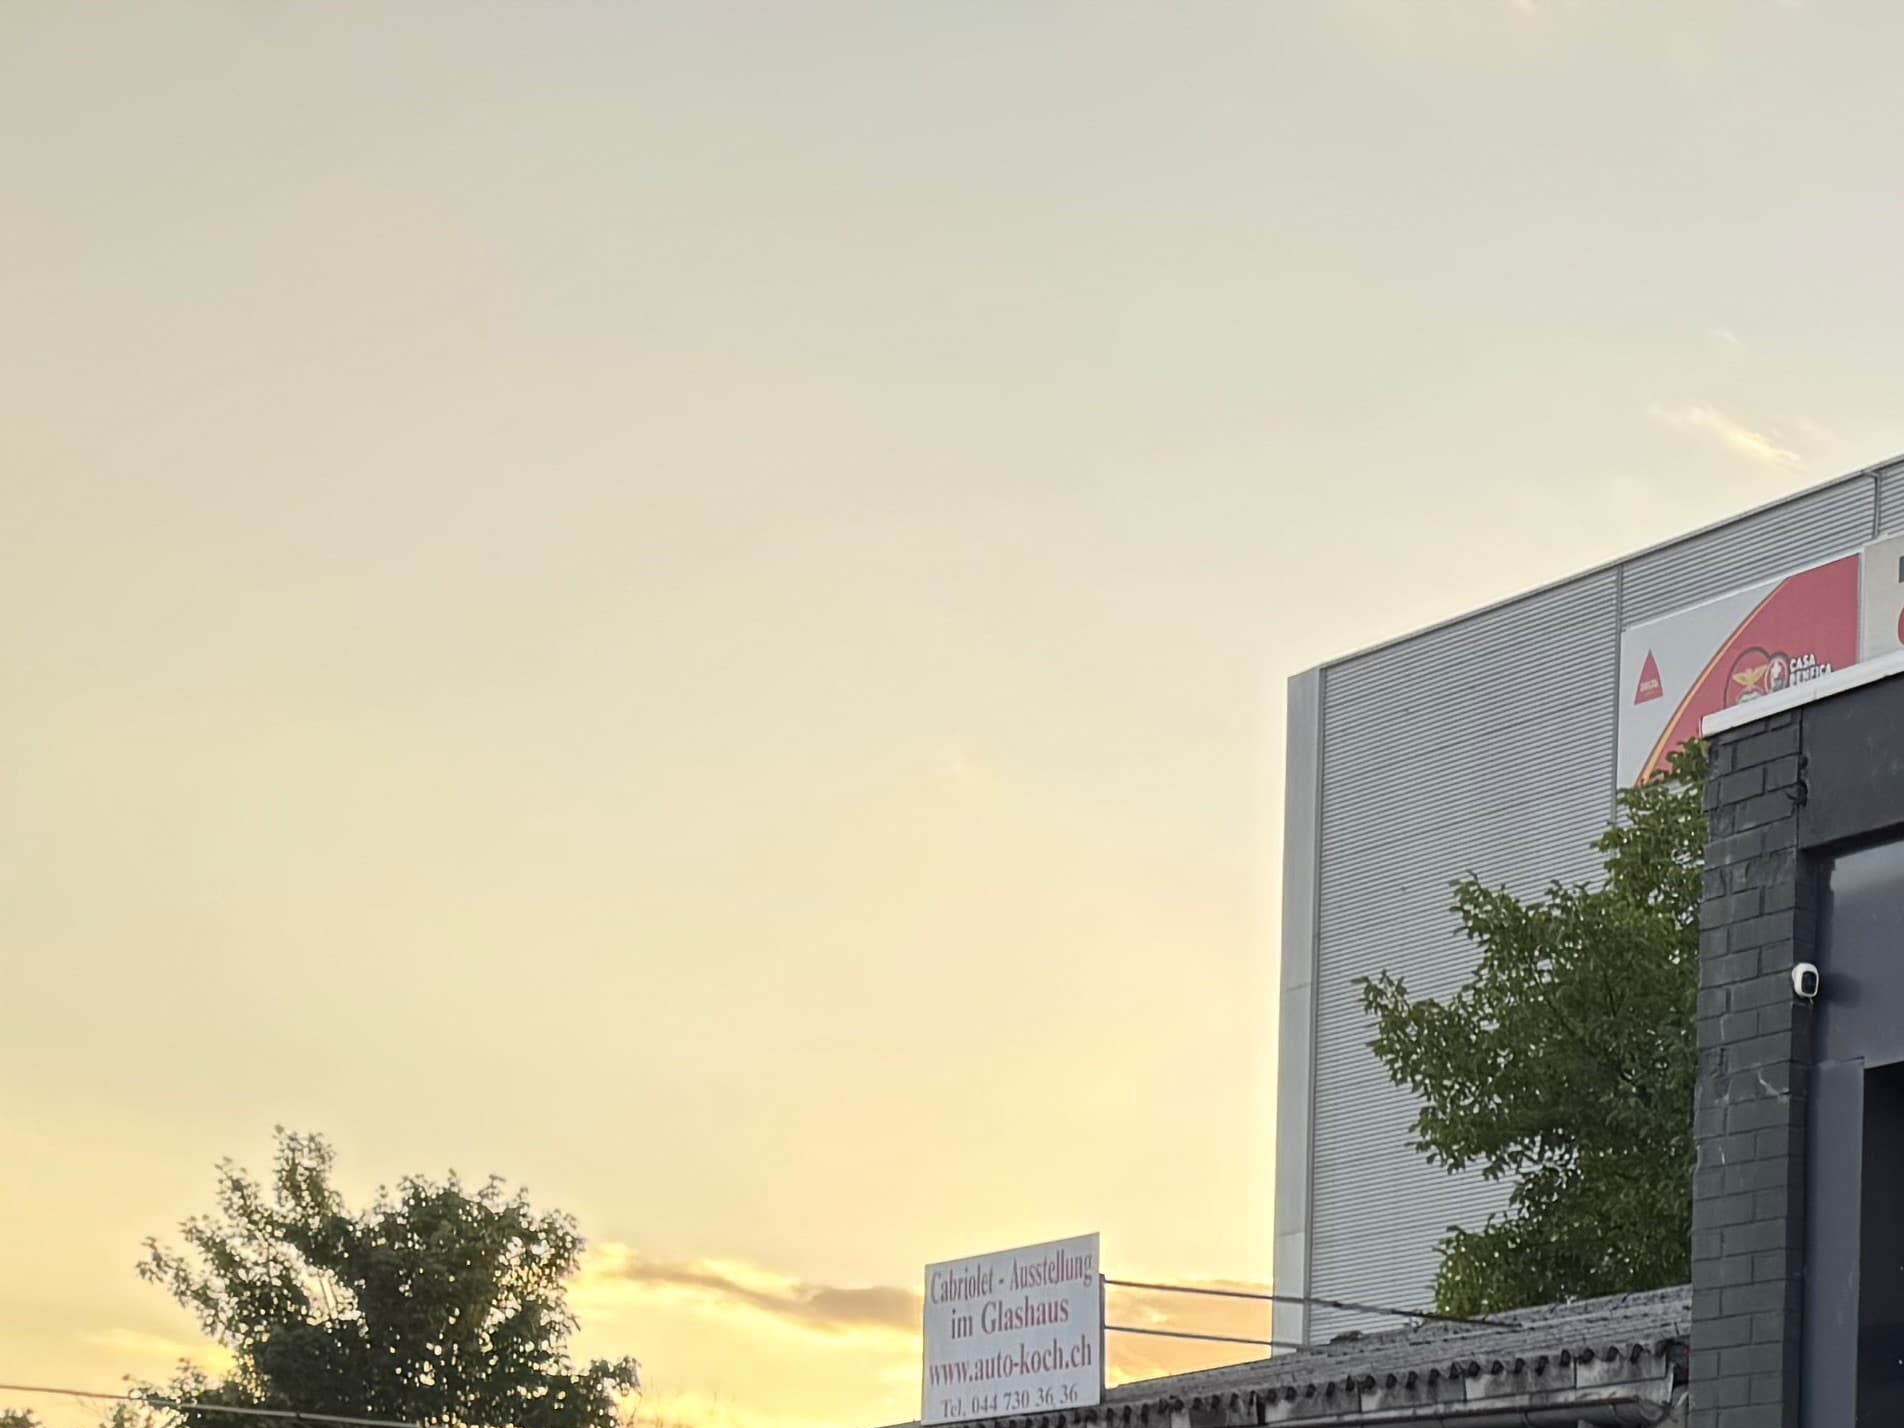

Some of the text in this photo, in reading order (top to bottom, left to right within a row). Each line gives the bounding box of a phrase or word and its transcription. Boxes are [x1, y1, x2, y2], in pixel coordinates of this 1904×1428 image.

[1790, 653, 1816, 672] CASA
[931, 1264, 994, 1304] Cabriolet
[1010, 1249, 1092, 1291] Ausstellung
[952, 1297, 1069, 1339] im Glashaus
[929, 1335, 1092, 1386] www.auto-koch.ch
[942, 1382, 1078, 1418] Tel. 044 730 36 36
